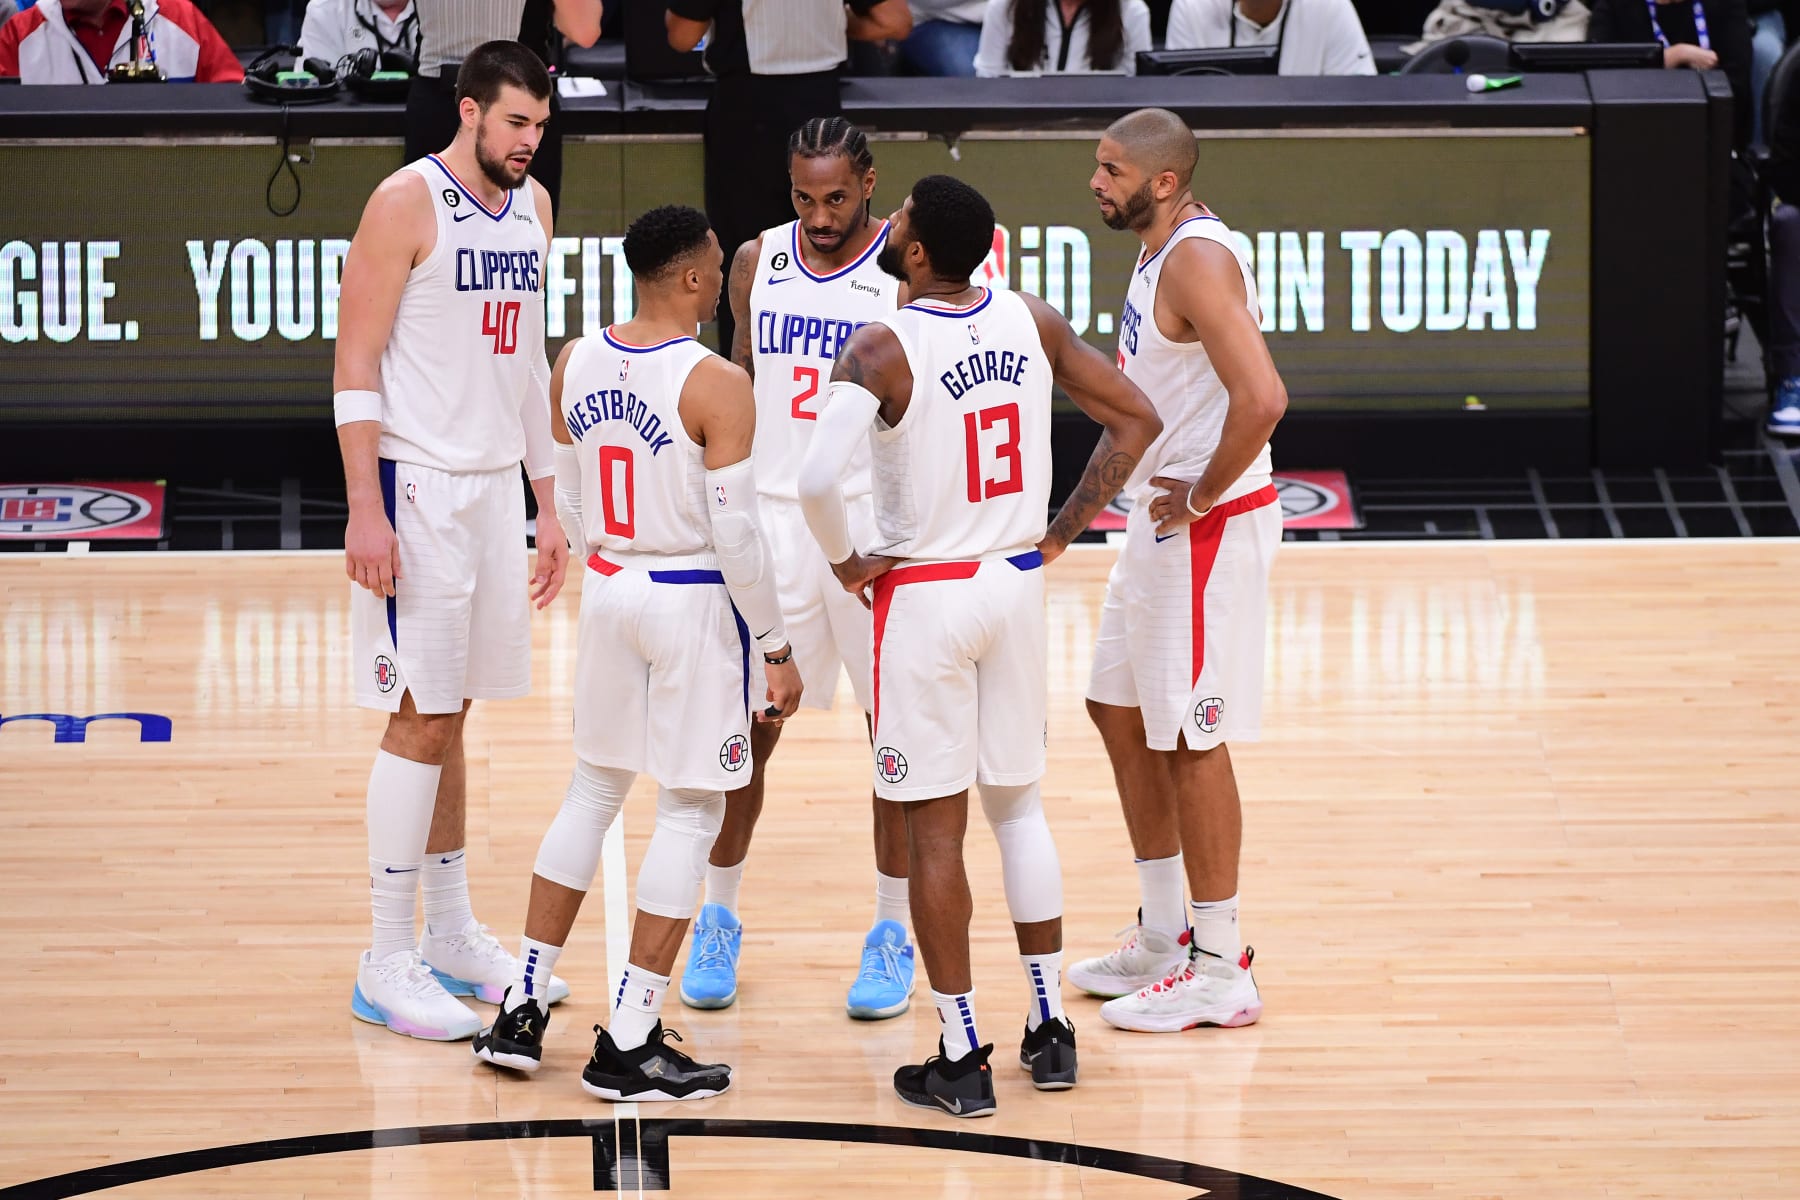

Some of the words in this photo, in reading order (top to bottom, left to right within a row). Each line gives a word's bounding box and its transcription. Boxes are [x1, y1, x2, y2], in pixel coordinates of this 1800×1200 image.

[445, 191, 458, 206] 6
[456, 248, 539, 292] CLIPPERS
[774, 252, 787, 270] 6
[850, 279, 881, 297] honey
[1340, 229, 1551, 332] TODAY
[482, 301, 521, 355] 40
[791, 366, 819, 421] 2
[940, 351, 1029, 401] GEORGE
[567, 389, 674, 457] WESTBROOK
[963, 402, 1024, 503] 13
[598, 445, 635, 540] 0
